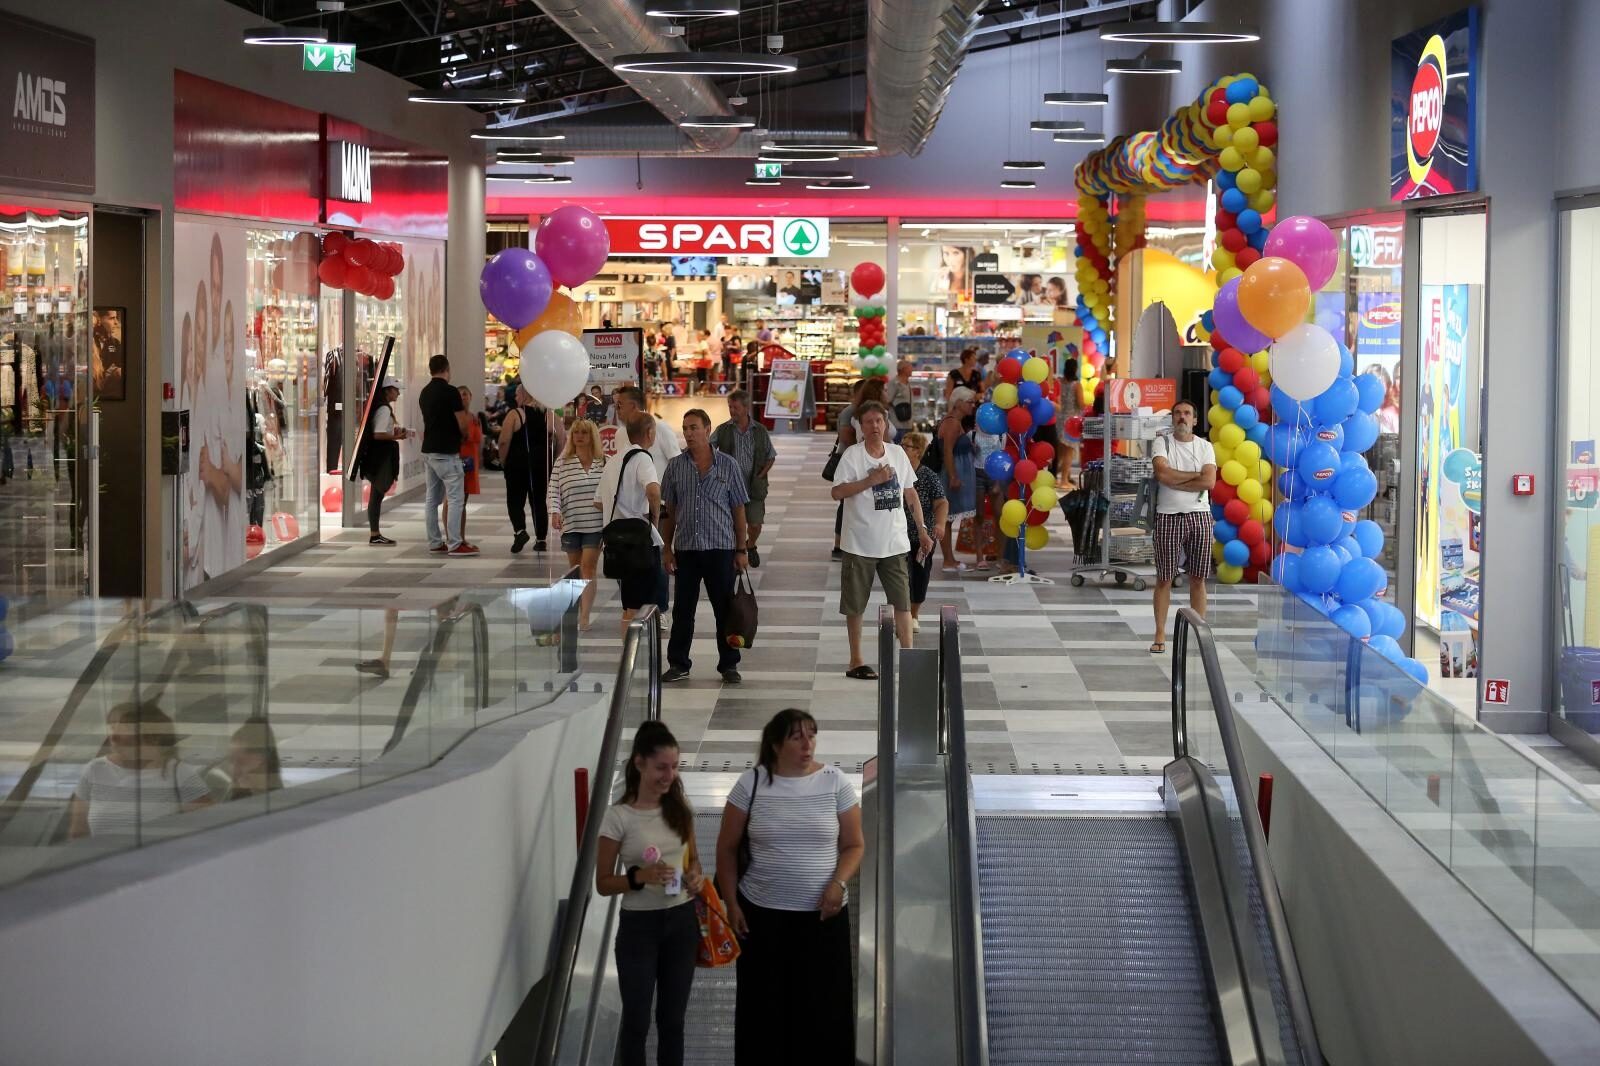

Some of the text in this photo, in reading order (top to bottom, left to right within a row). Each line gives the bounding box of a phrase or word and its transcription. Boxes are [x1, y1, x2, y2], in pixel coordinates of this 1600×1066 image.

[1412, 86, 1440, 134] PEPCO
[341, 140, 372, 204] MANA
[638, 223, 772, 250] SPAR
[597, 335, 621, 344] MANA
[589, 362, 610, 370] entar
